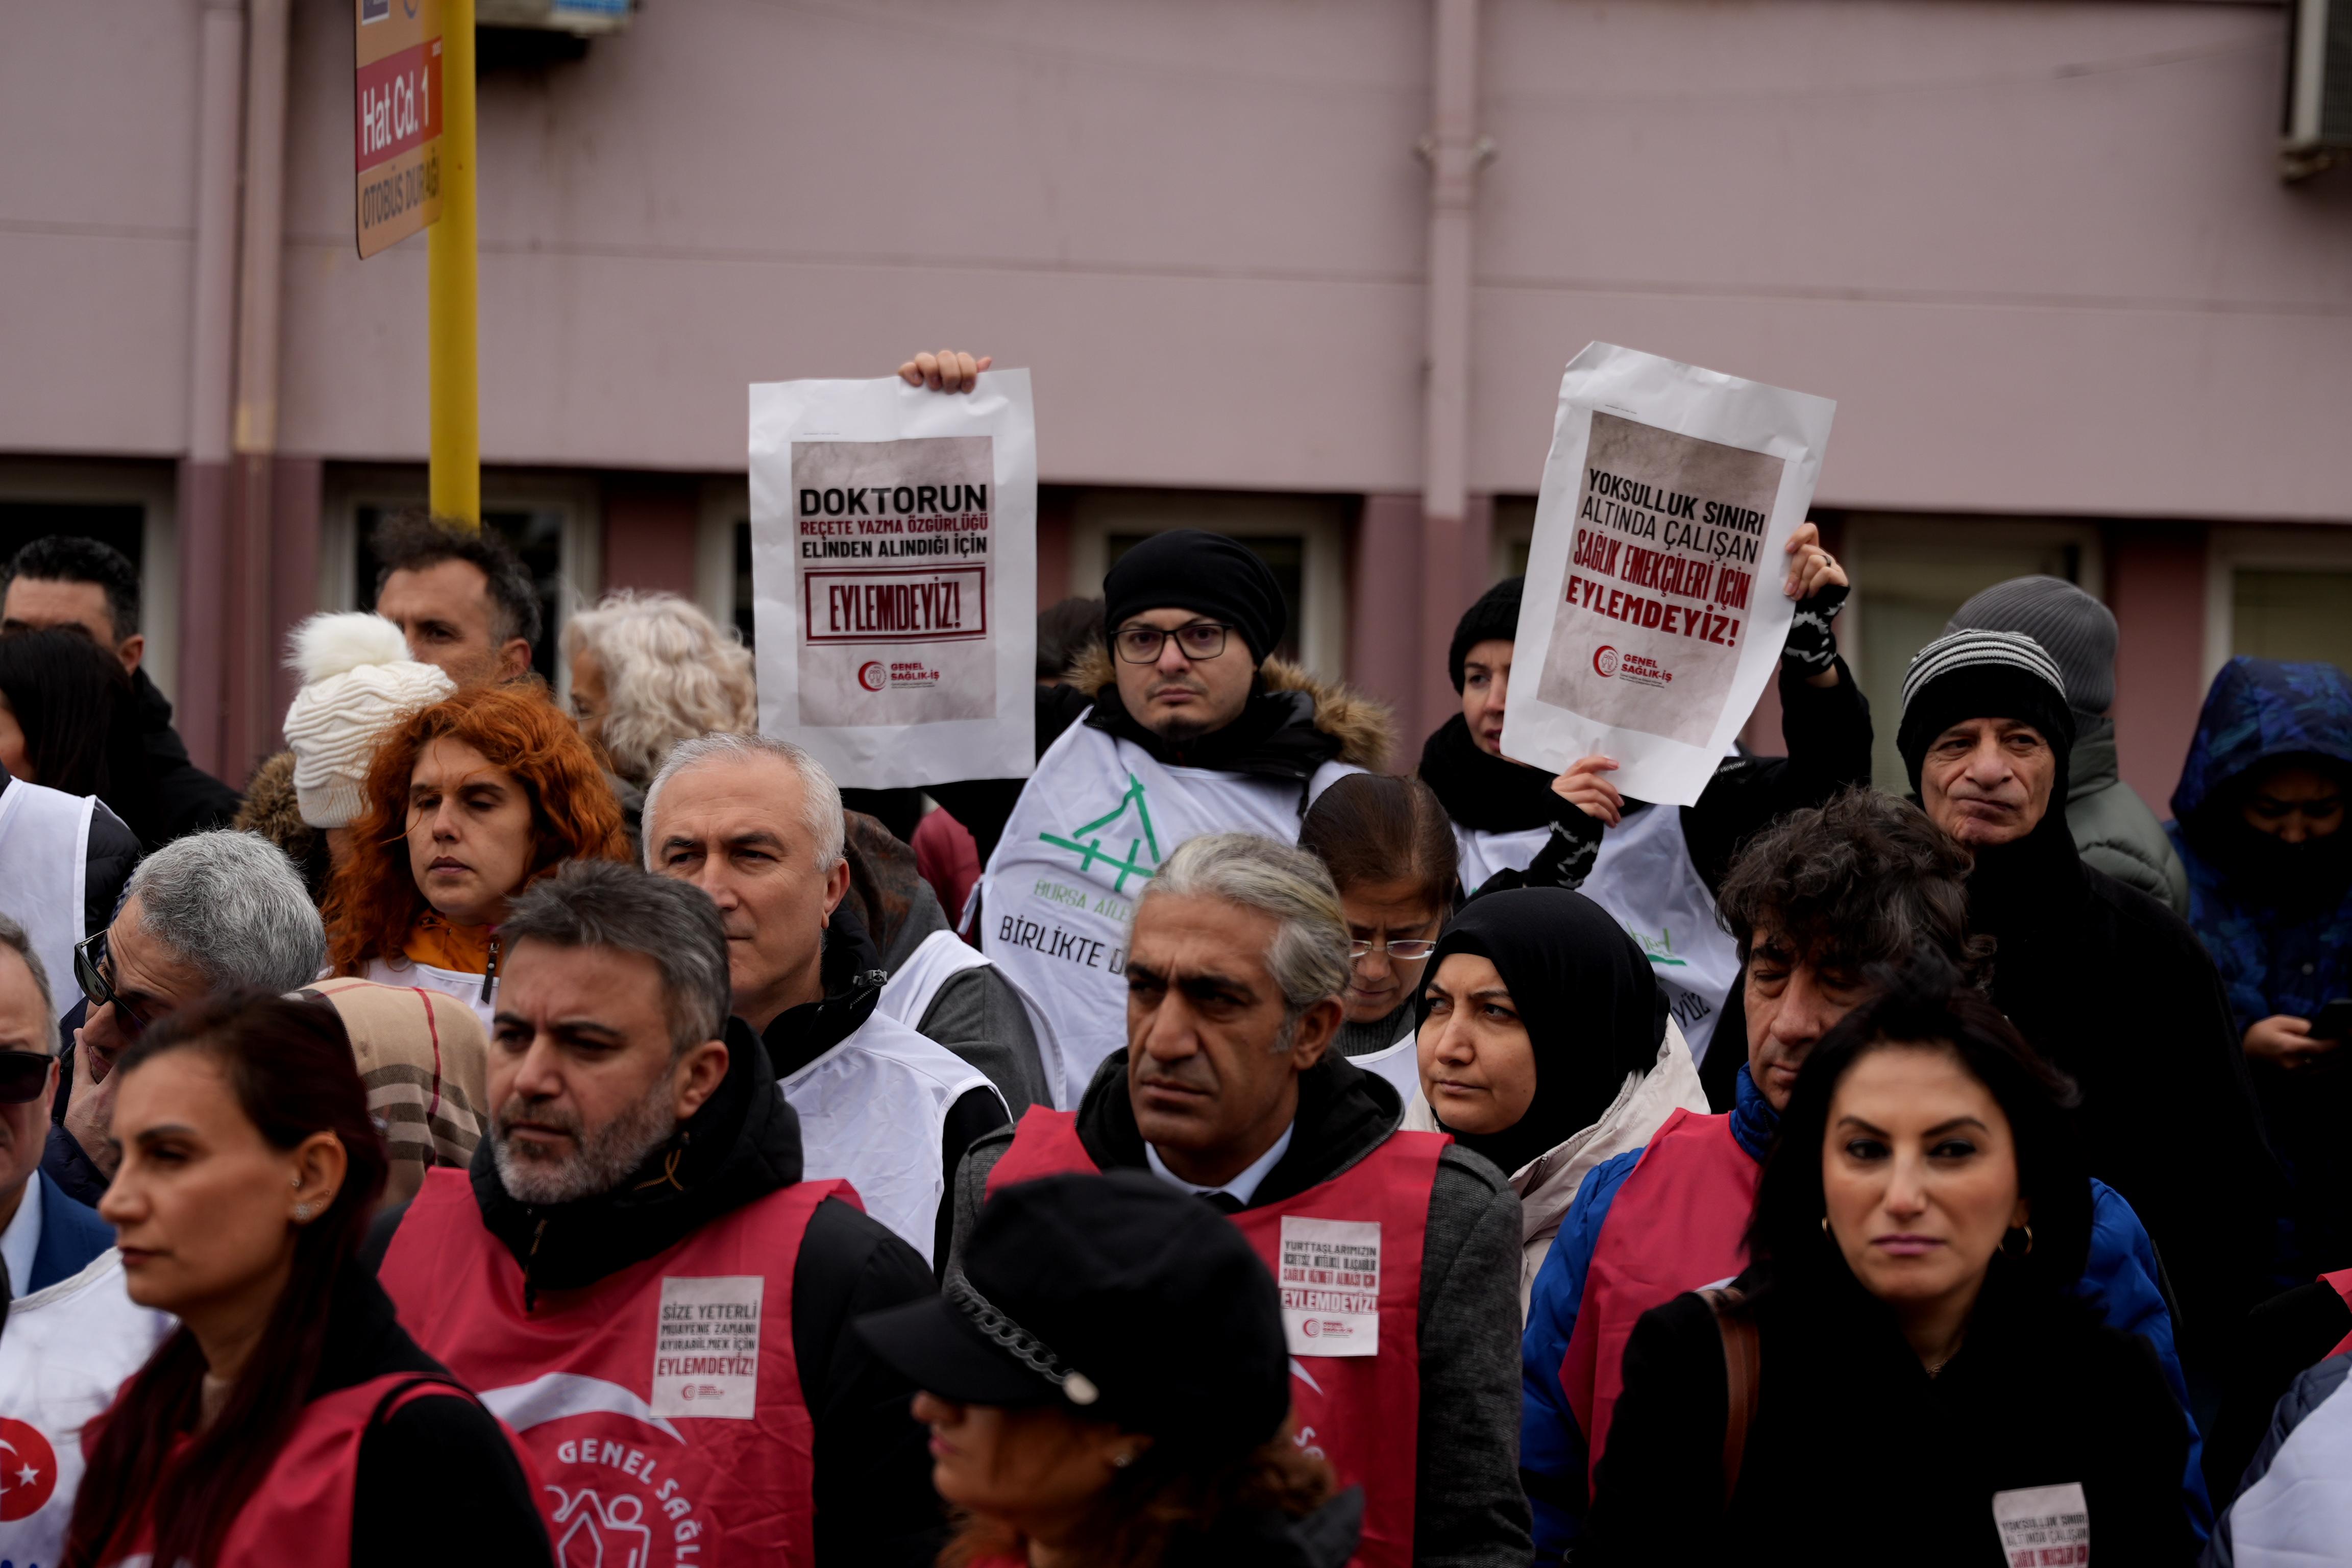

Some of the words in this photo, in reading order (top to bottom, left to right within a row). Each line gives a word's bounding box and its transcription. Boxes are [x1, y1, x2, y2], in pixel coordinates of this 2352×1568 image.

[363, 82, 391, 155] Hat
[394, 69, 419, 140] Cd.
[421, 64, 429, 128] 1
[363, 164, 403, 229] OTOBÜS
[800, 484, 987, 516] DOKTORUN
[1589, 468, 1699, 521] YOKSULLUK
[1702, 500, 1766, 536] SINIRI
[800, 521, 853, 540] REÇETE
[857, 519, 903, 534] YAZMA
[908, 512, 988, 534] ÖZGÜRLÜĞÜ
[1581, 496, 1655, 541] ALTINDA
[1663, 520, 1759, 565] ÇALIŞAN
[802, 539, 872, 558] ELİNDEN
[878, 535, 949, 557] ALINDIĞI
[954, 534, 987, 558] İÇİN
[1573, 529, 1622, 577] SAĞLIK
[1621, 545, 1718, 601] EMEKÇİLERİ
[1717, 562, 1751, 610] İÇİN
[829, 577, 961, 632] EYLEMDEYİZ!
[1565, 575, 1740, 647] EYLEMDEYİZ!
[891, 663, 924, 671] GENEL
[891, 669, 940, 681] SAĞLIK-İŞ
[1621, 664, 1673, 683] SAĞLIK-İŞ
[1624, 654, 1658, 669] GENEL
[1034, 879, 1087, 910] BURSA
[998, 915, 1106, 968] BİRLİKTE
[663, 1301, 693, 1320] SİZE
[698, 1300, 757, 1320] YETERLİ
[1280, 1290, 1377, 1314] EYLEMDEYİZ!
[657, 1352, 754, 1376] EYLEMDEYİZ!
[557, 1438, 656, 1485] GENEL
